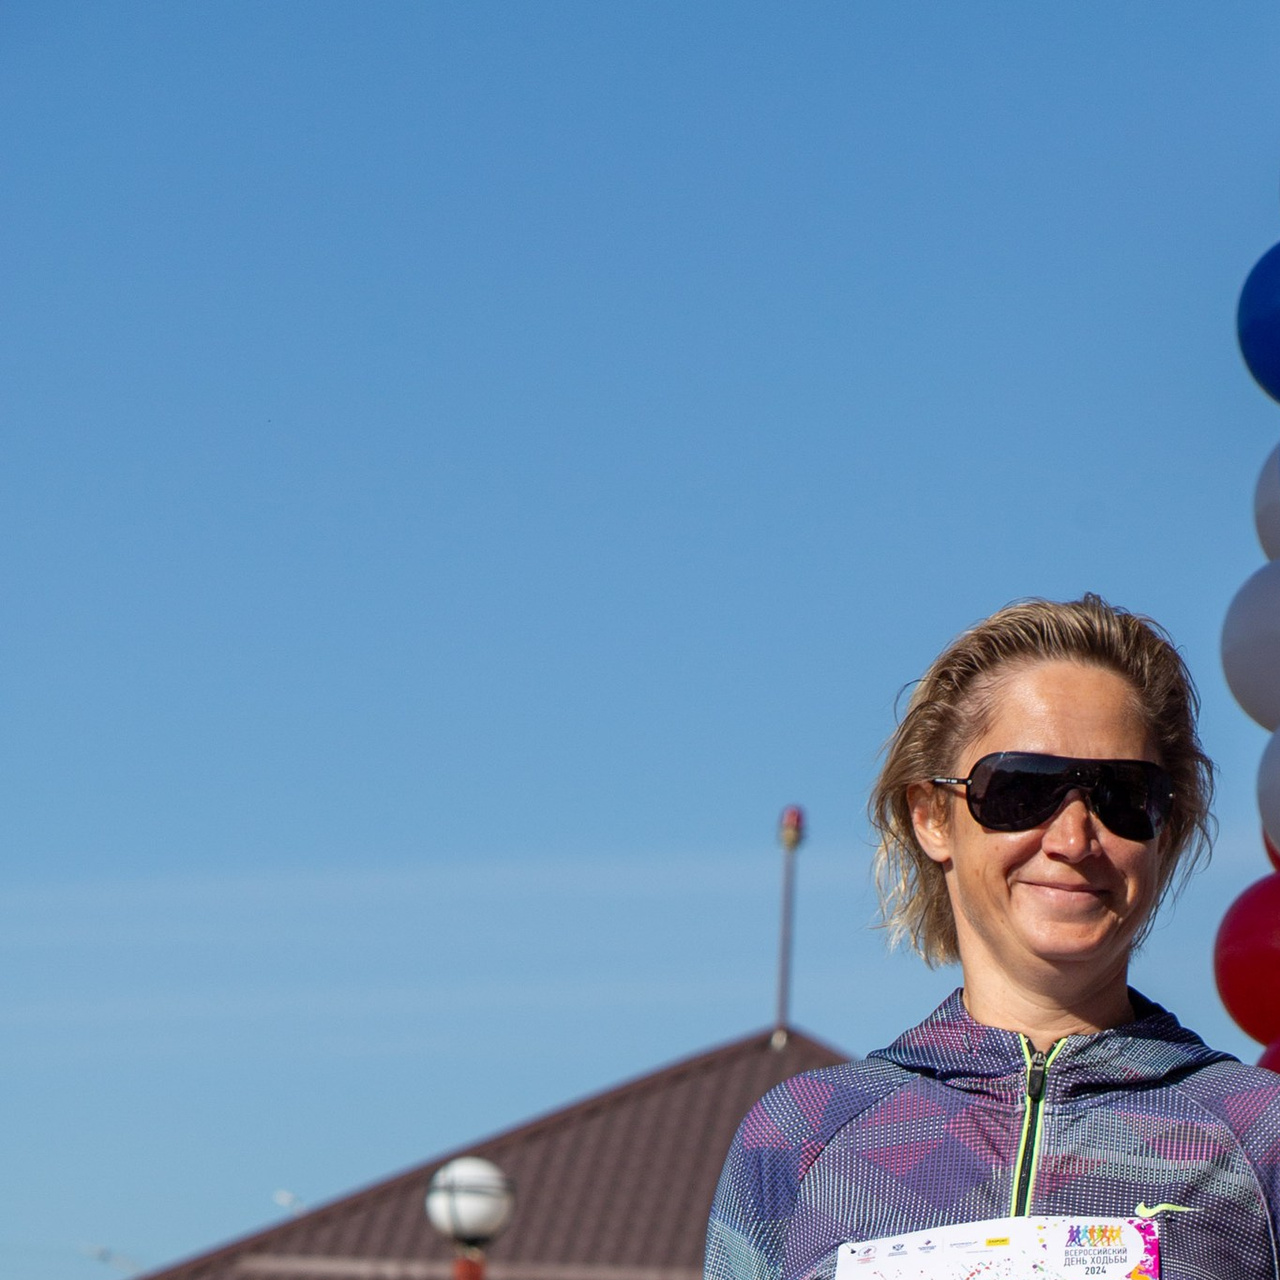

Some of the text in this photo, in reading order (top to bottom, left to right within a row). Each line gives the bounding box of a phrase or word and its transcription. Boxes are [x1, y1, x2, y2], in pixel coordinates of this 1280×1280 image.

[1064, 1247, 1127, 1257] ВСЕРОССИЙСКИЙ
[1064, 1256, 1127, 1267] ДЕНЬ ХОДЬБЫ
[1085, 1266, 1107, 1275] 2024
